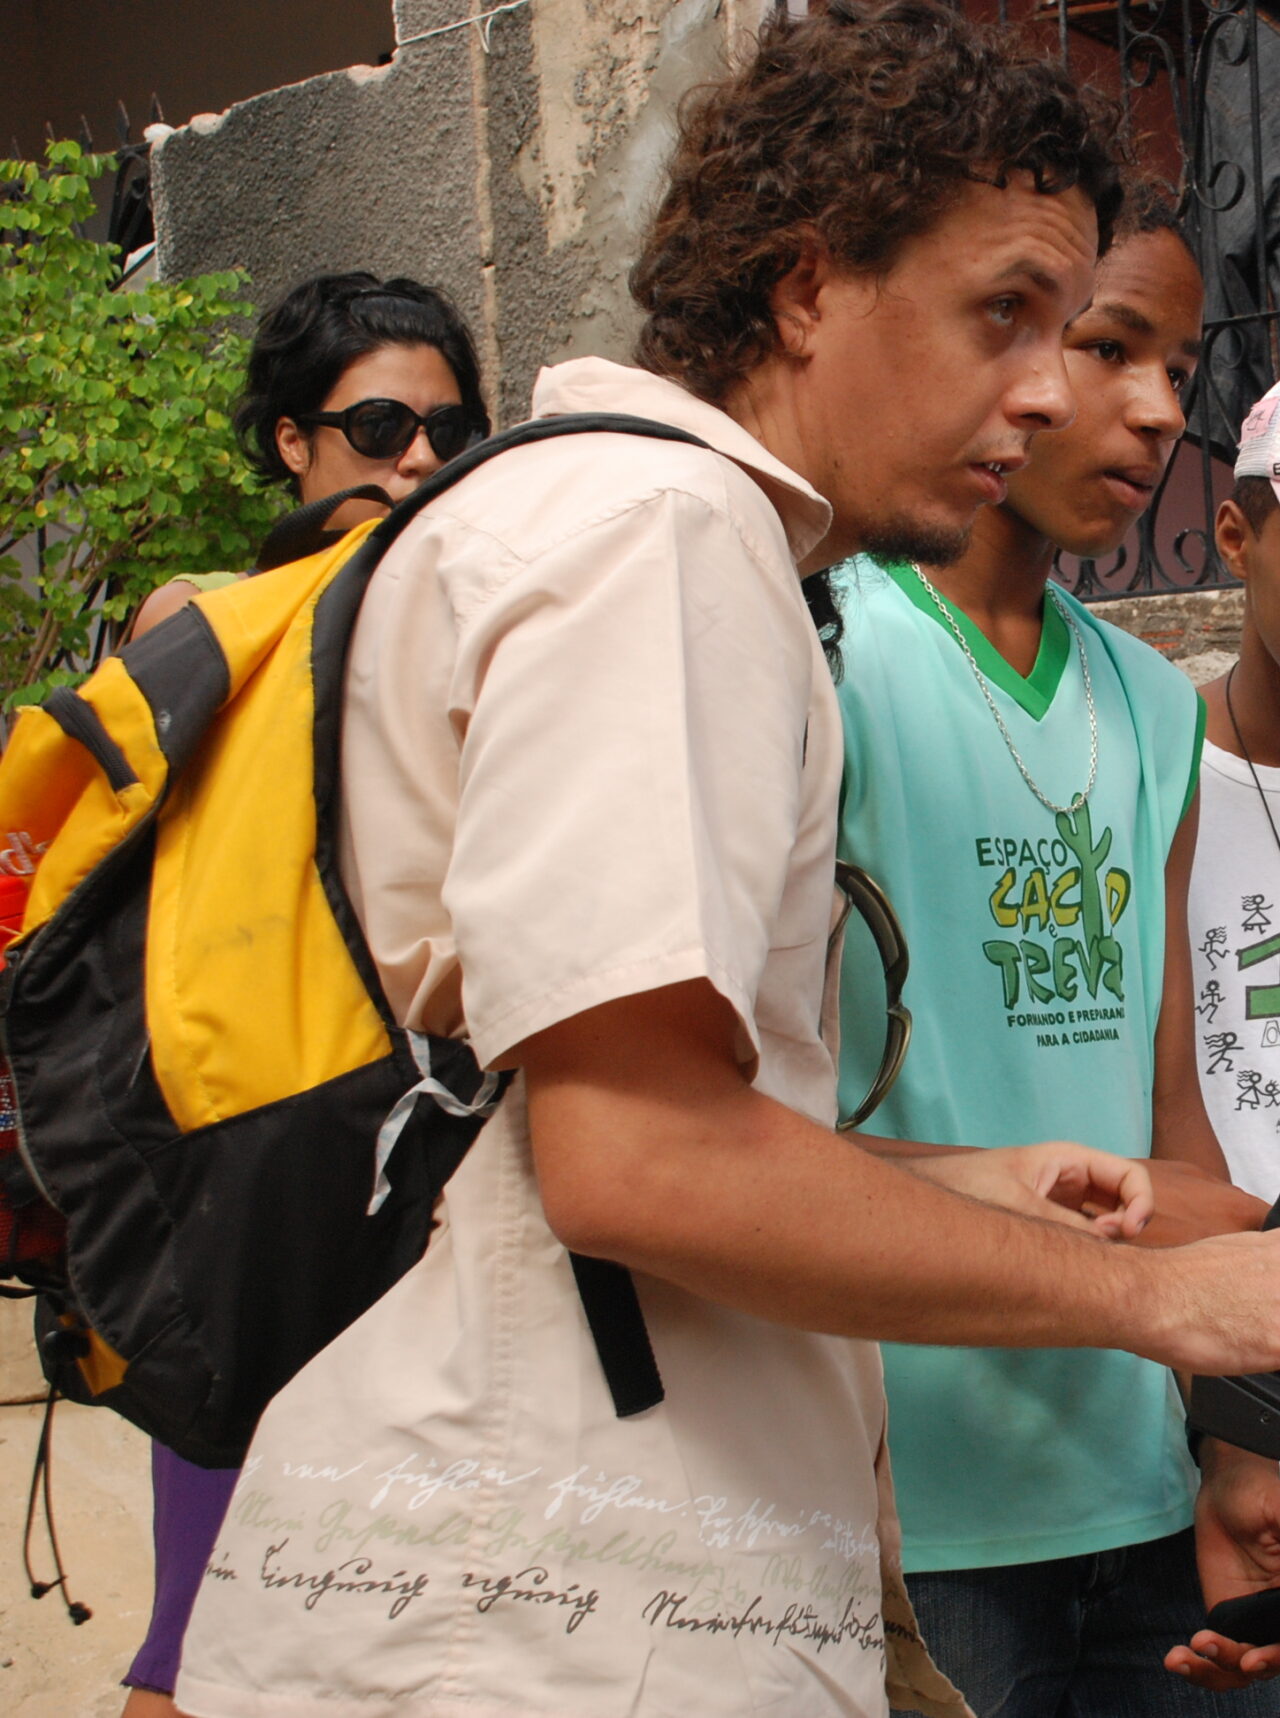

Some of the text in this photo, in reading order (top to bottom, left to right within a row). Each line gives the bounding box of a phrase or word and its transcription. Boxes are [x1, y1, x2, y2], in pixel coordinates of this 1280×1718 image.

[975, 837, 1068, 874] ESPAÇO
[1048, 923, 1058, 938] e
[1007, 1007, 1125, 1028] FORMANDO E PREPARAN
[1036, 1028, 1120, 1047] PARA A CIDADANIA
